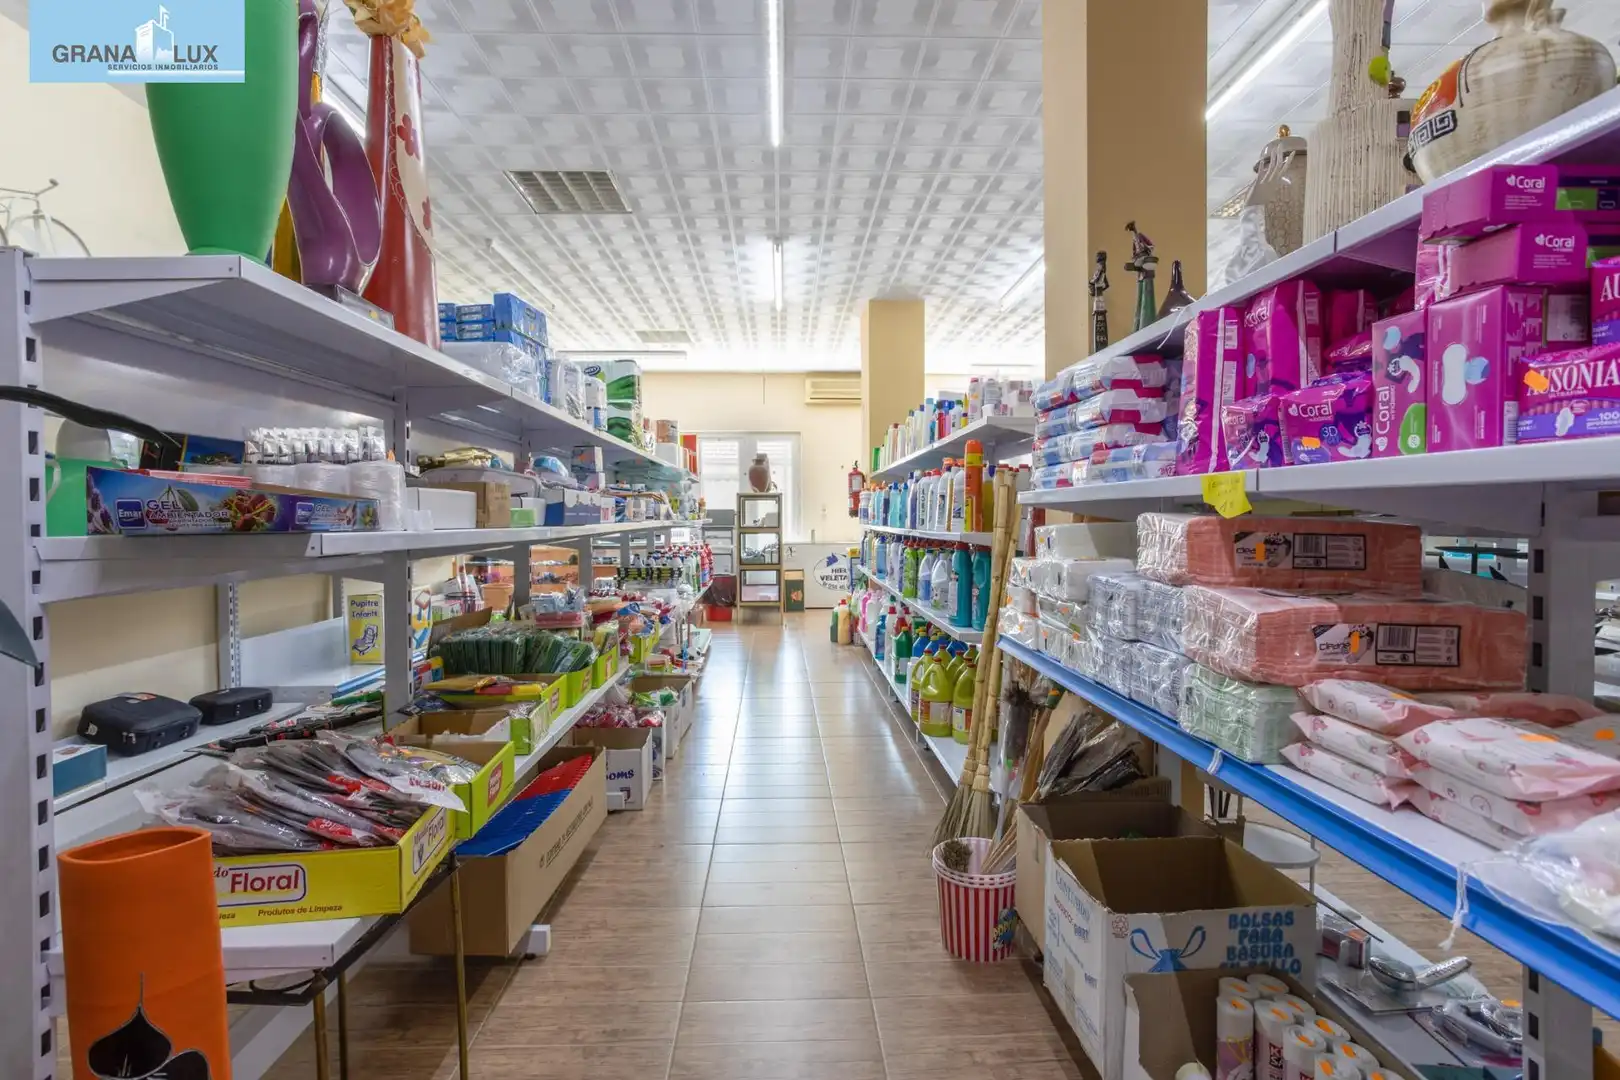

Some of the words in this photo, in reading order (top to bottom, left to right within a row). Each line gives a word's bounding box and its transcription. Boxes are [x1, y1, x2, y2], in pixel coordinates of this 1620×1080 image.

[1516, 175, 1546, 189] Coral
[1545, 235, 1575, 248] Coral
[1299, 401, 1333, 418] Coral
[1375, 386, 1390, 435] Coral
[1322, 425, 1339, 437] 3D
[146, 499, 182, 510] GEL
[118, 509, 142, 518] Emar
[148, 511, 229, 520] AMBIENTADOR
[351, 600, 379, 608] Pupitre
[230, 869, 300, 894] Floral
[257, 908, 295, 917] Produtos
[297, 905, 308, 914] de
[308, 904, 343, 914] Limpeza
[1228, 910, 1294, 930] BOLSAS
[1238, 927, 1283, 946] PARA
[1226, 942, 1294, 961] BASURA
